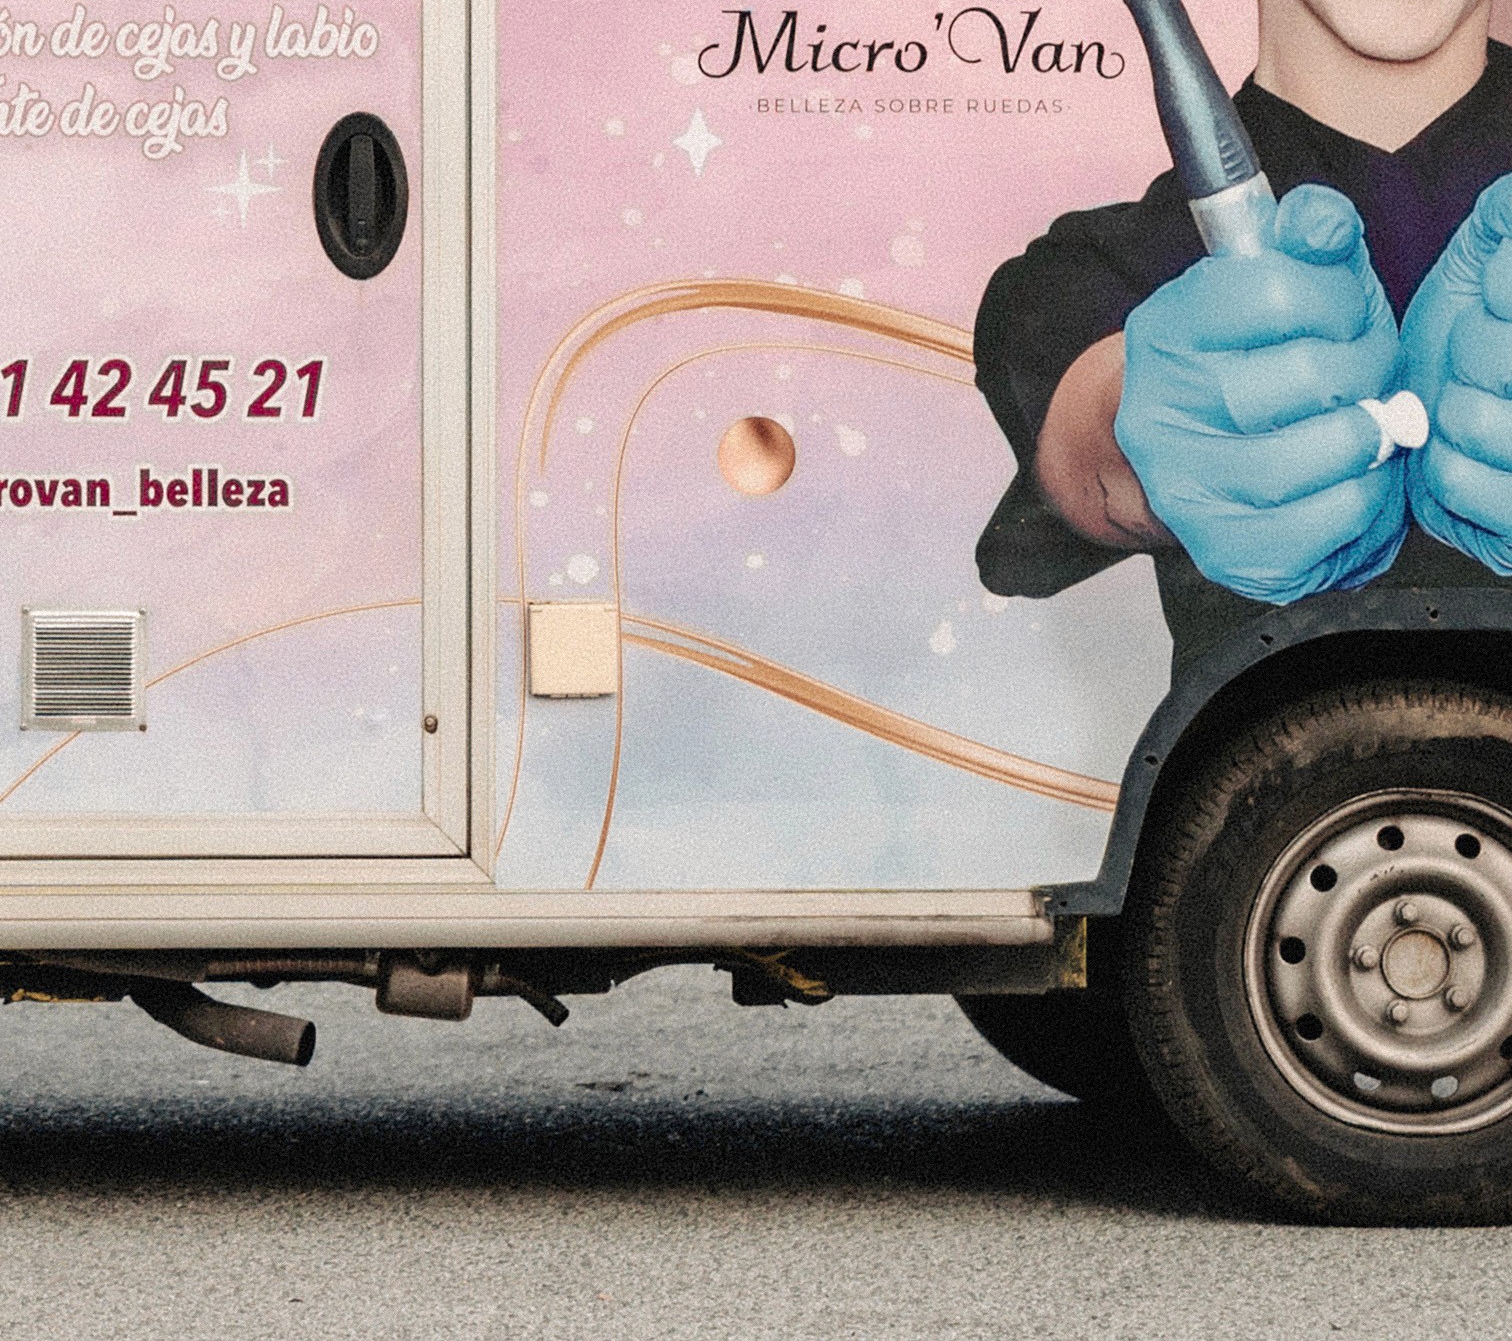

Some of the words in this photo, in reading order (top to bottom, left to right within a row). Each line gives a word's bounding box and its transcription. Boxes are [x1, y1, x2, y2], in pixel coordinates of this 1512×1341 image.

[50, 3, 112, 59] de
[114, 4, 221, 82] cejas
[215, 18, 258, 83] y
[263, 3, 380, 60] labio
[59, 80, 121, 138] de
[122, 84, 231, 161] cejas
[756, 98, 864, 114] BELLEZA
[874, 98, 955, 114] SOBRE
[966, 98, 1064, 114] RUEDAS
[48, 358, 133, 419] 42
[147, 358, 231, 419] 45
[246, 358, 324, 419] 21
